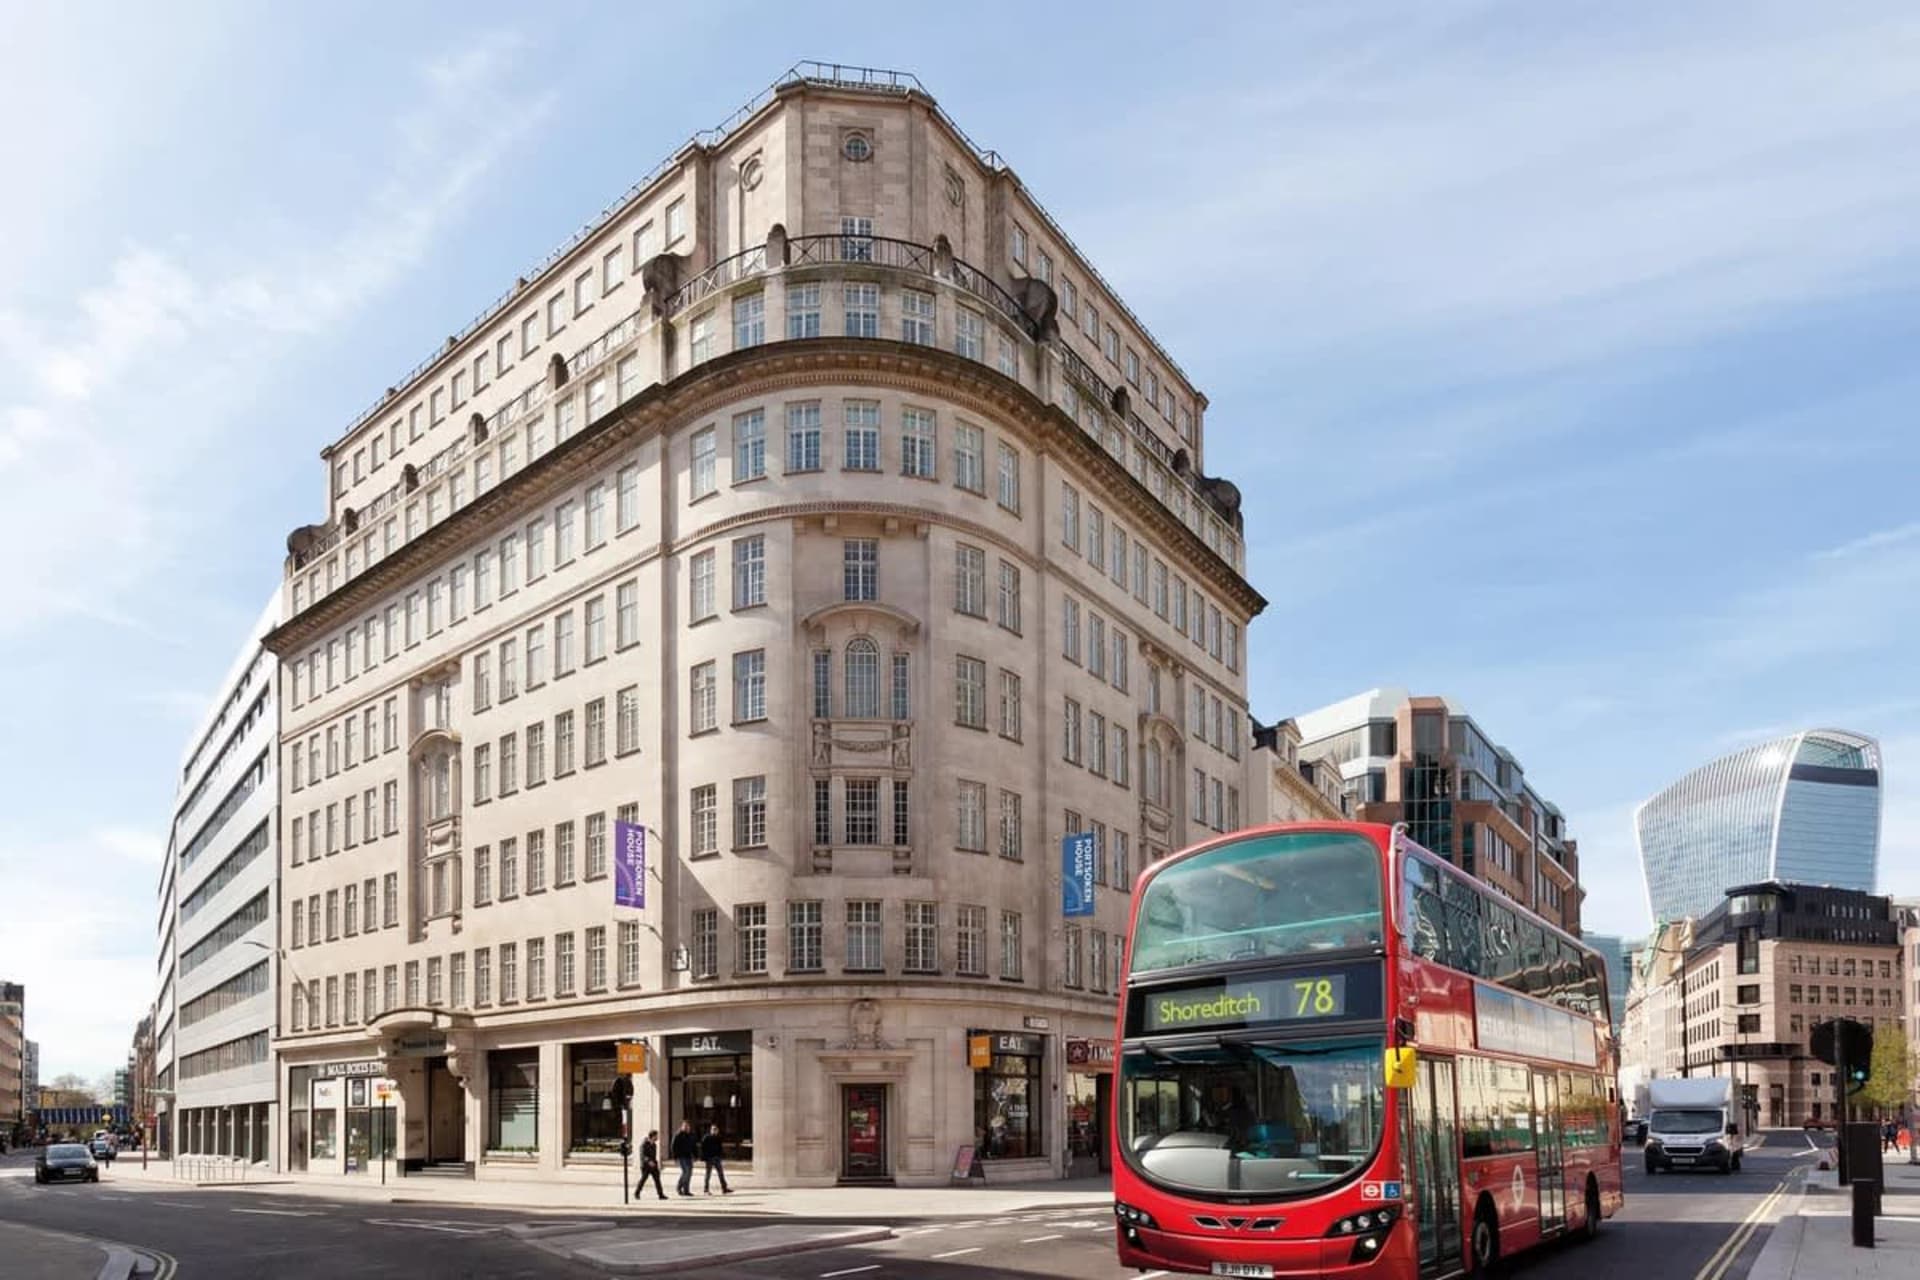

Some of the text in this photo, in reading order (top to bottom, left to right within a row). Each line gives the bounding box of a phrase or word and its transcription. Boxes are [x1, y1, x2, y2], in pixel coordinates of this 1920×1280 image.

[626, 829, 635, 865] HOUSE
[635, 831, 643, 896] PORTSOKEN
[1075, 840, 1083, 877] HOUSE
[1083, 838, 1092, 903] PORTSOKEN
[1159, 979, 1334, 1023] Shoreditch 78
[691, 1036, 721, 1052] EAT.
